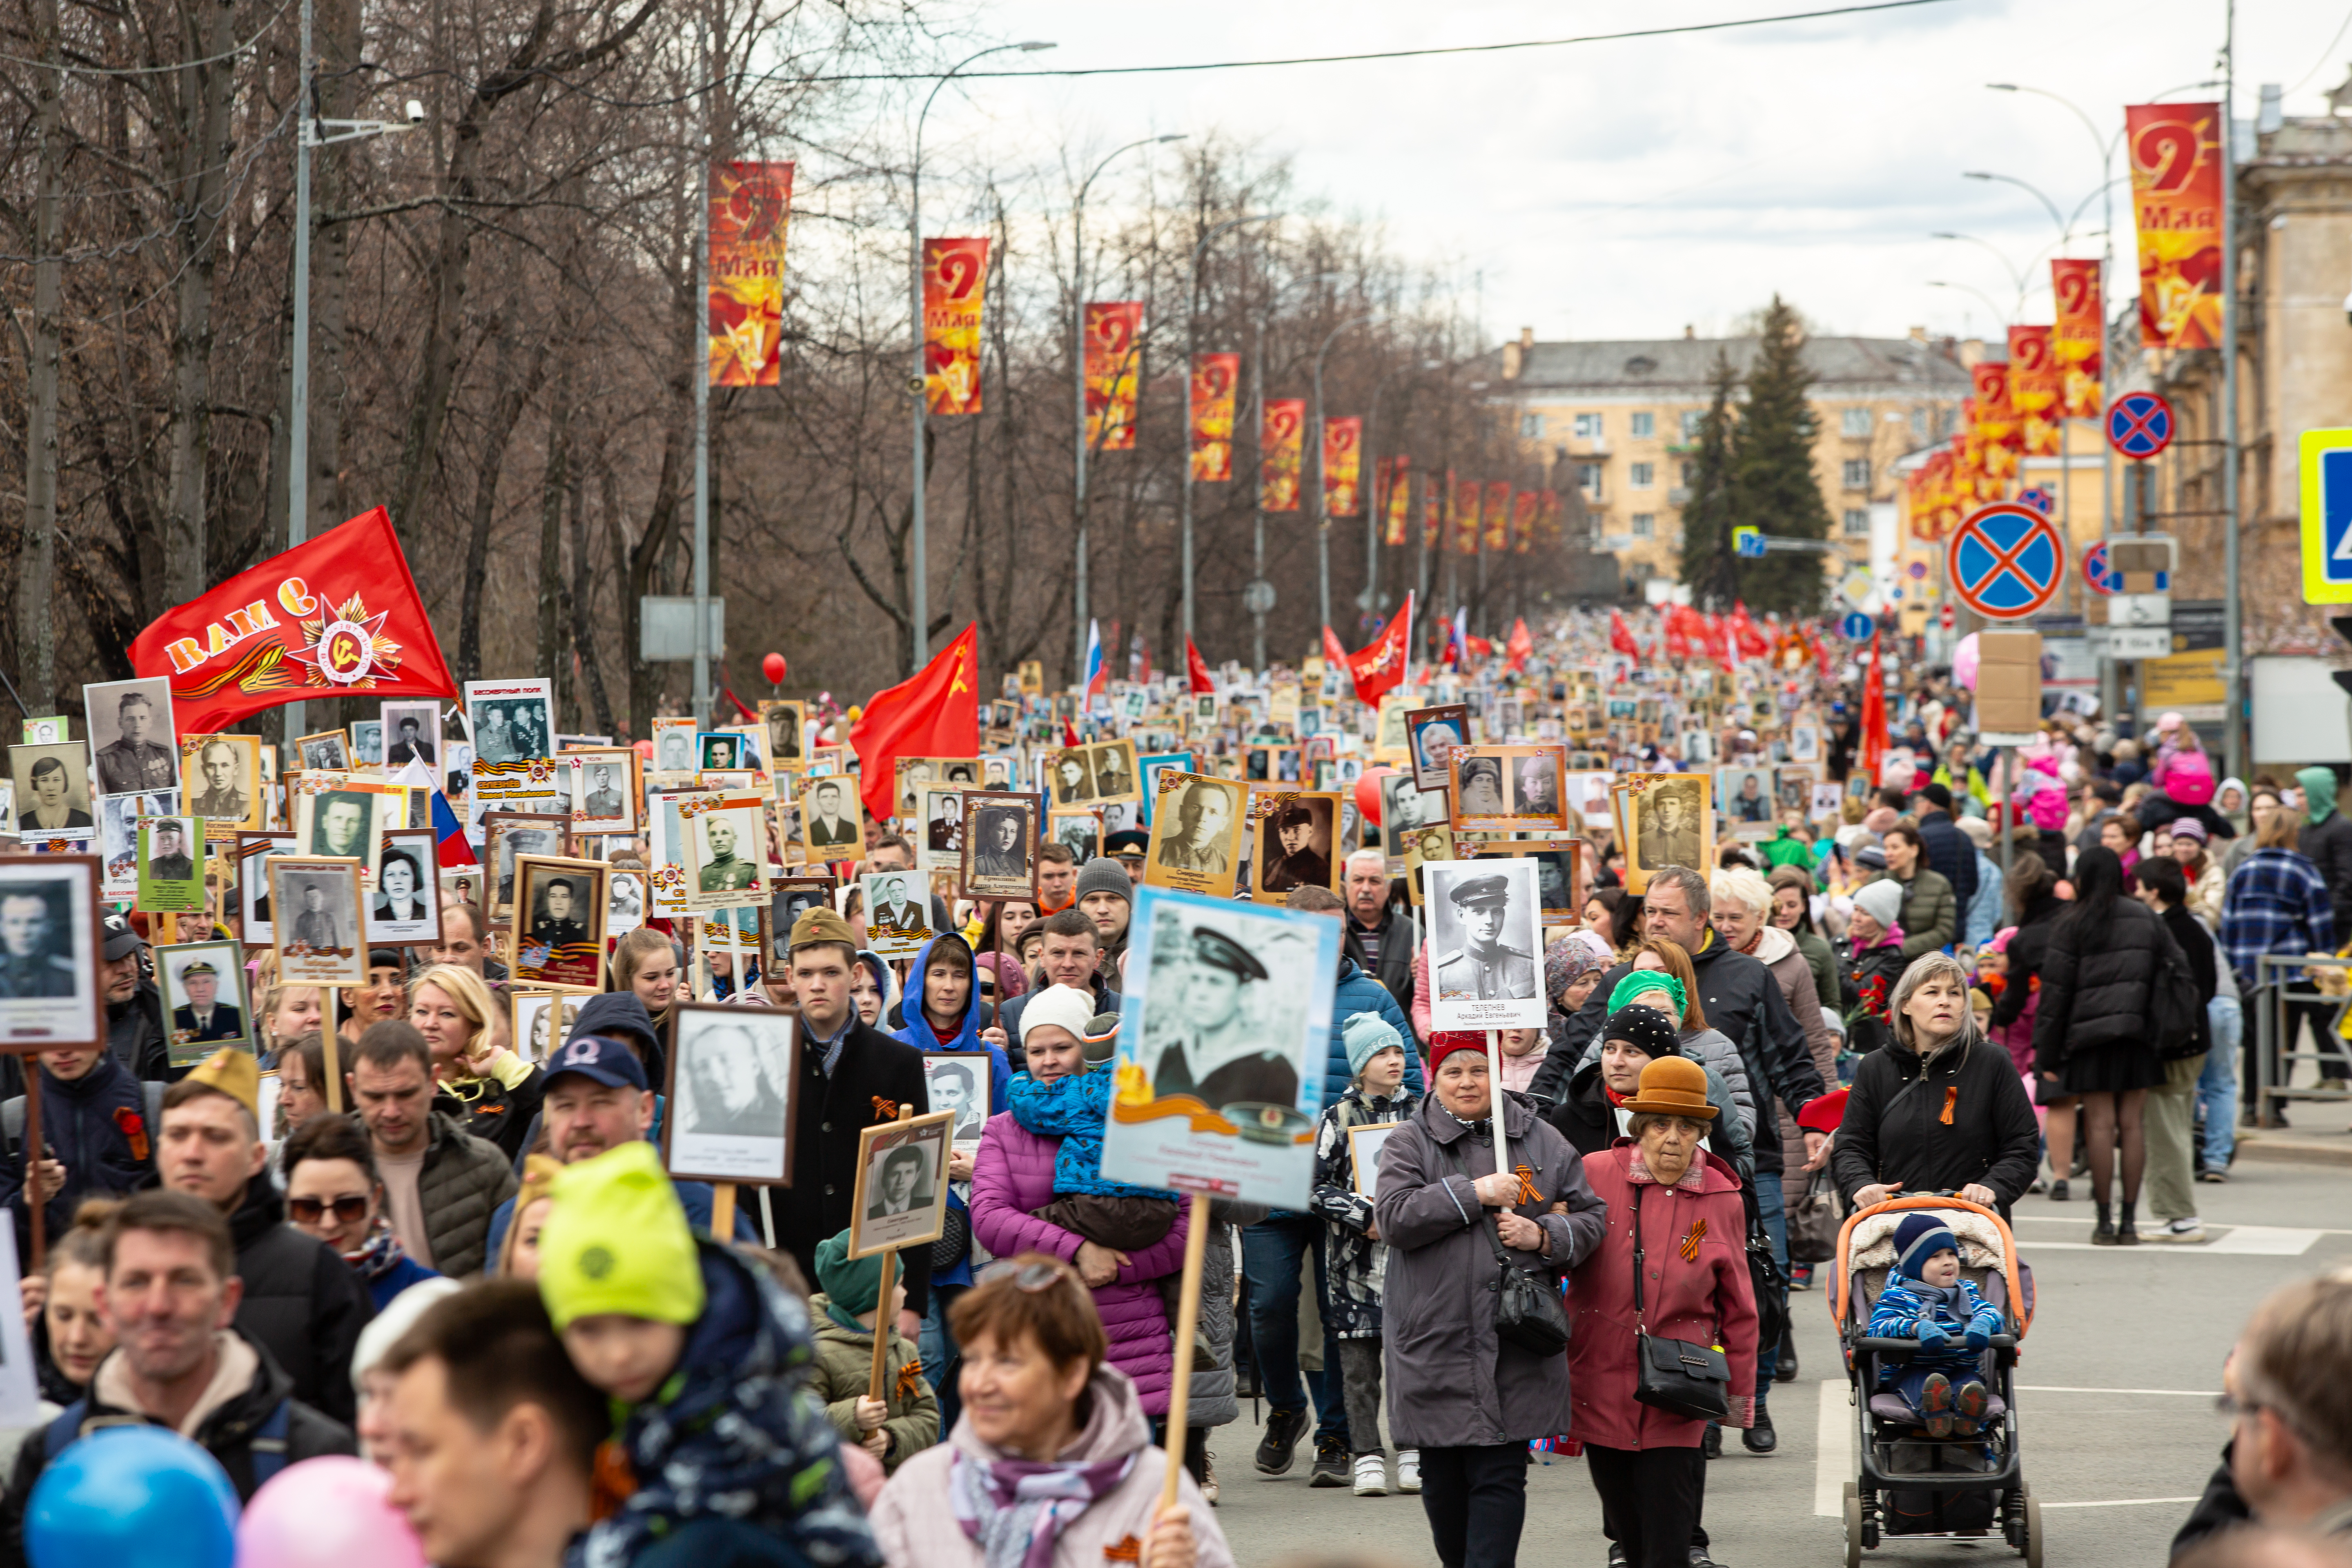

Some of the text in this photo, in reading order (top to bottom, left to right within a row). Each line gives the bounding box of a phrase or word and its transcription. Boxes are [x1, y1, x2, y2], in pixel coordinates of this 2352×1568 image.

[2133, 122, 2200, 193] 9
[728, 180, 784, 243] 9
[2141, 206, 2216, 229] Мая
[717, 255, 778, 276] Мая
[939, 251, 981, 301] 9
[2058, 272, 2089, 314] 9
[929, 311, 975, 327] Мая
[1098, 314, 1135, 355] 9
[2017, 337, 2046, 371] 9
[1203, 365, 1231, 399] 9
[1980, 375, 2005, 403] 9
[1273, 411, 1298, 439] 9
[1333, 428, 1355, 451] 9
[1176, 869, 1205, 878] Смирнов
[1457, 1012, 1483, 1021] Аркадий
